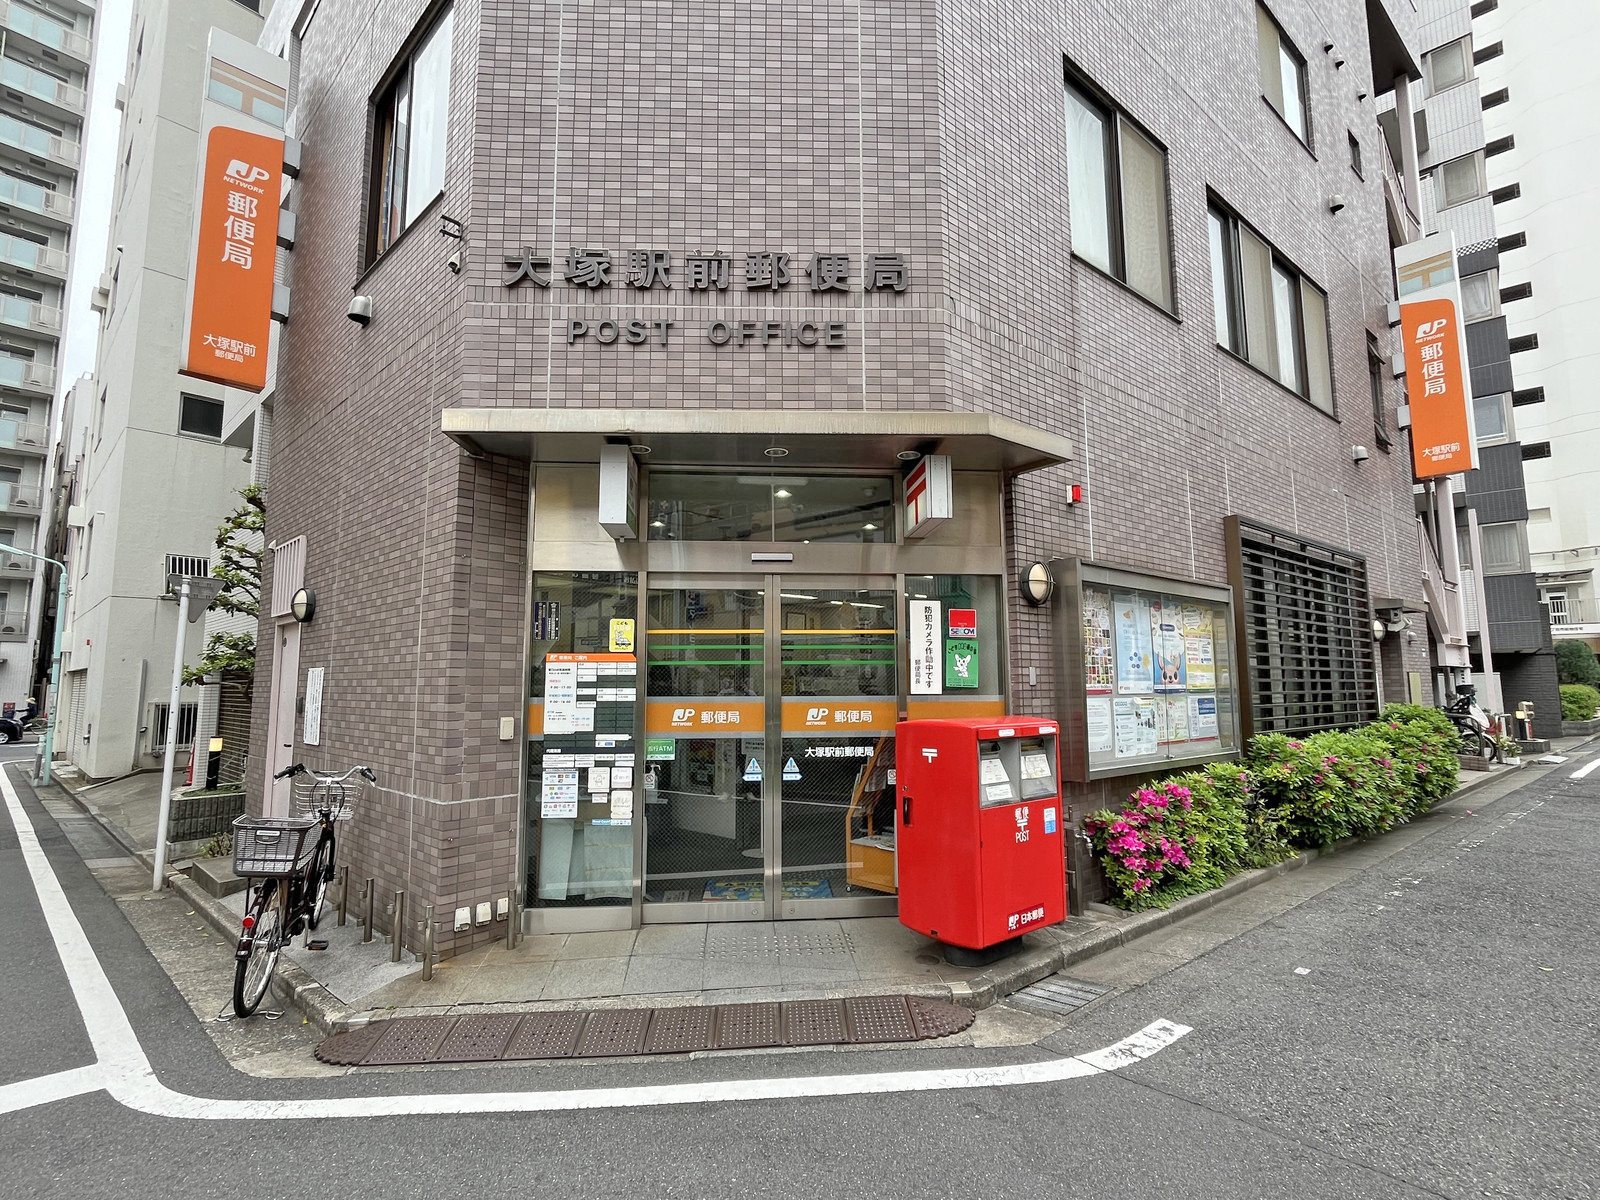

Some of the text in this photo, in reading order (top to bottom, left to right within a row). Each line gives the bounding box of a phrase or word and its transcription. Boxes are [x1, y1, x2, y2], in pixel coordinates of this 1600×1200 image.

[223, 176, 264, 194] NETWORK
[221, 190, 258, 270] 郵便局
[503, 246, 909, 292] 大塚駅前郵便局
[567, 319, 846, 347] POST OFFICE
[203, 333, 257, 357] 大塚駅前
[214, 349, 244, 362] 郵便局
[1420, 342, 1447, 398] 郵便局
[1422, 442, 1460, 458] 大塚駅前
[924, 605, 934, 689] 防犯カメラ作動中です
[701, 711, 740, 724] 郵便局
[834, 710, 873, 723] 郵便局
[804, 746, 875, 758] 大塚駅前郵便局
[1015, 830, 1029, 843] POST
